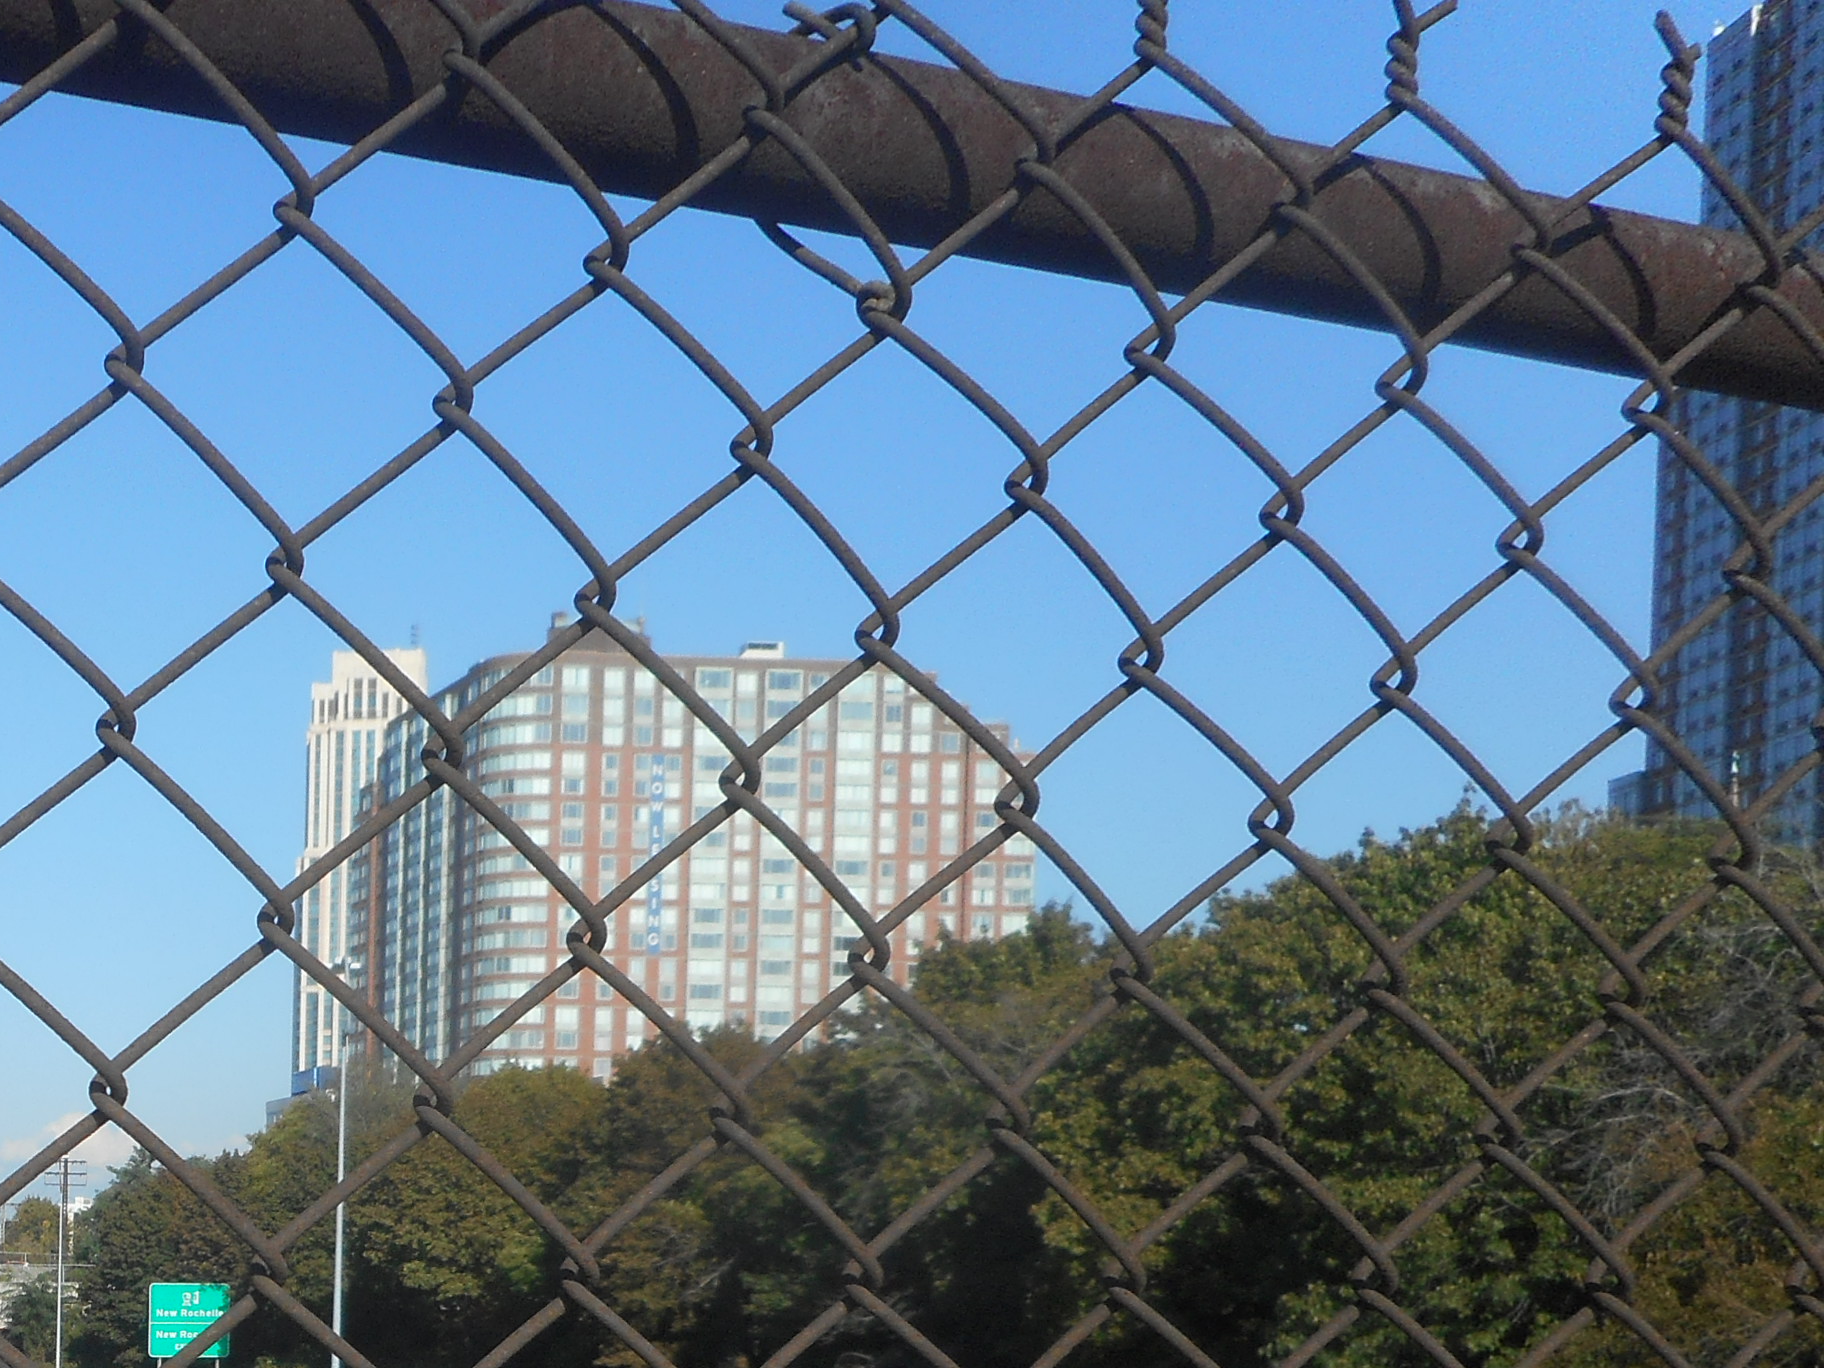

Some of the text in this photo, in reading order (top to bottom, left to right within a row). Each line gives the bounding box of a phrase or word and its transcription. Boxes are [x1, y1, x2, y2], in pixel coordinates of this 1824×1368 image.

[648, 764, 664, 945] NOW LESING
[156, 1309, 224, 1317] New Rochelle
[156, 1330, 177, 1338] New
